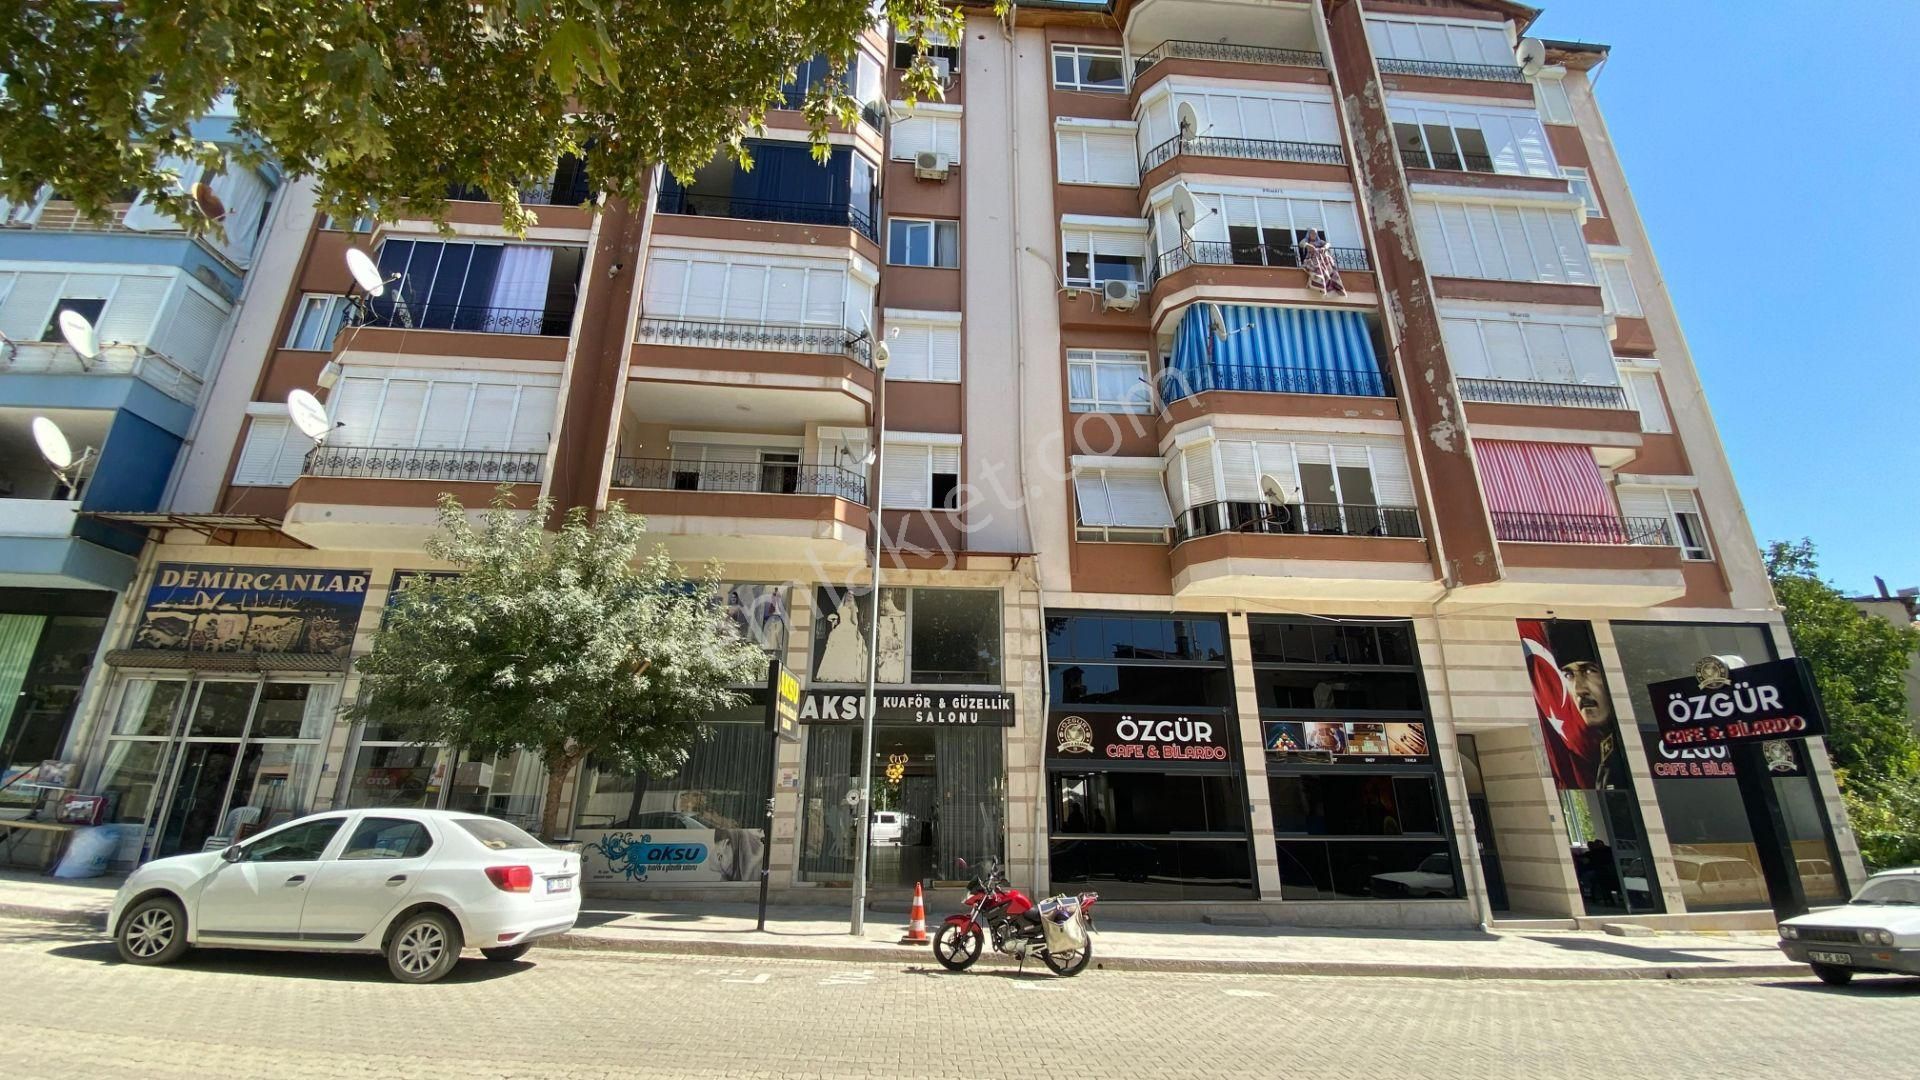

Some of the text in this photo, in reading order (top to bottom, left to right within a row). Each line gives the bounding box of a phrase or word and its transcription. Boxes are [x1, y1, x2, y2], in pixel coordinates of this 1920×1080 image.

[160, 568, 366, 592] DEMİRCANLAR
[781, 670, 799, 704] AKSU
[800, 695, 877, 720] AKSU
[883, 694, 931, 709] KUAFÖR
[938, 698, 946, 709] &
[952, 694, 1010, 710] GÜZELLİK
[1668, 681, 1784, 723] ÖZGÜR
[916, 711, 978, 724] SALONU
[1116, 715, 1212, 743] ÖZGÜR
[1664, 715, 1807, 744] CAFE & BİLARDO
[1106, 743, 1227, 760] CAFE & BİLARDO
[1654, 762, 1689, 776] CAFE
[1690, 763, 1702, 776] &
